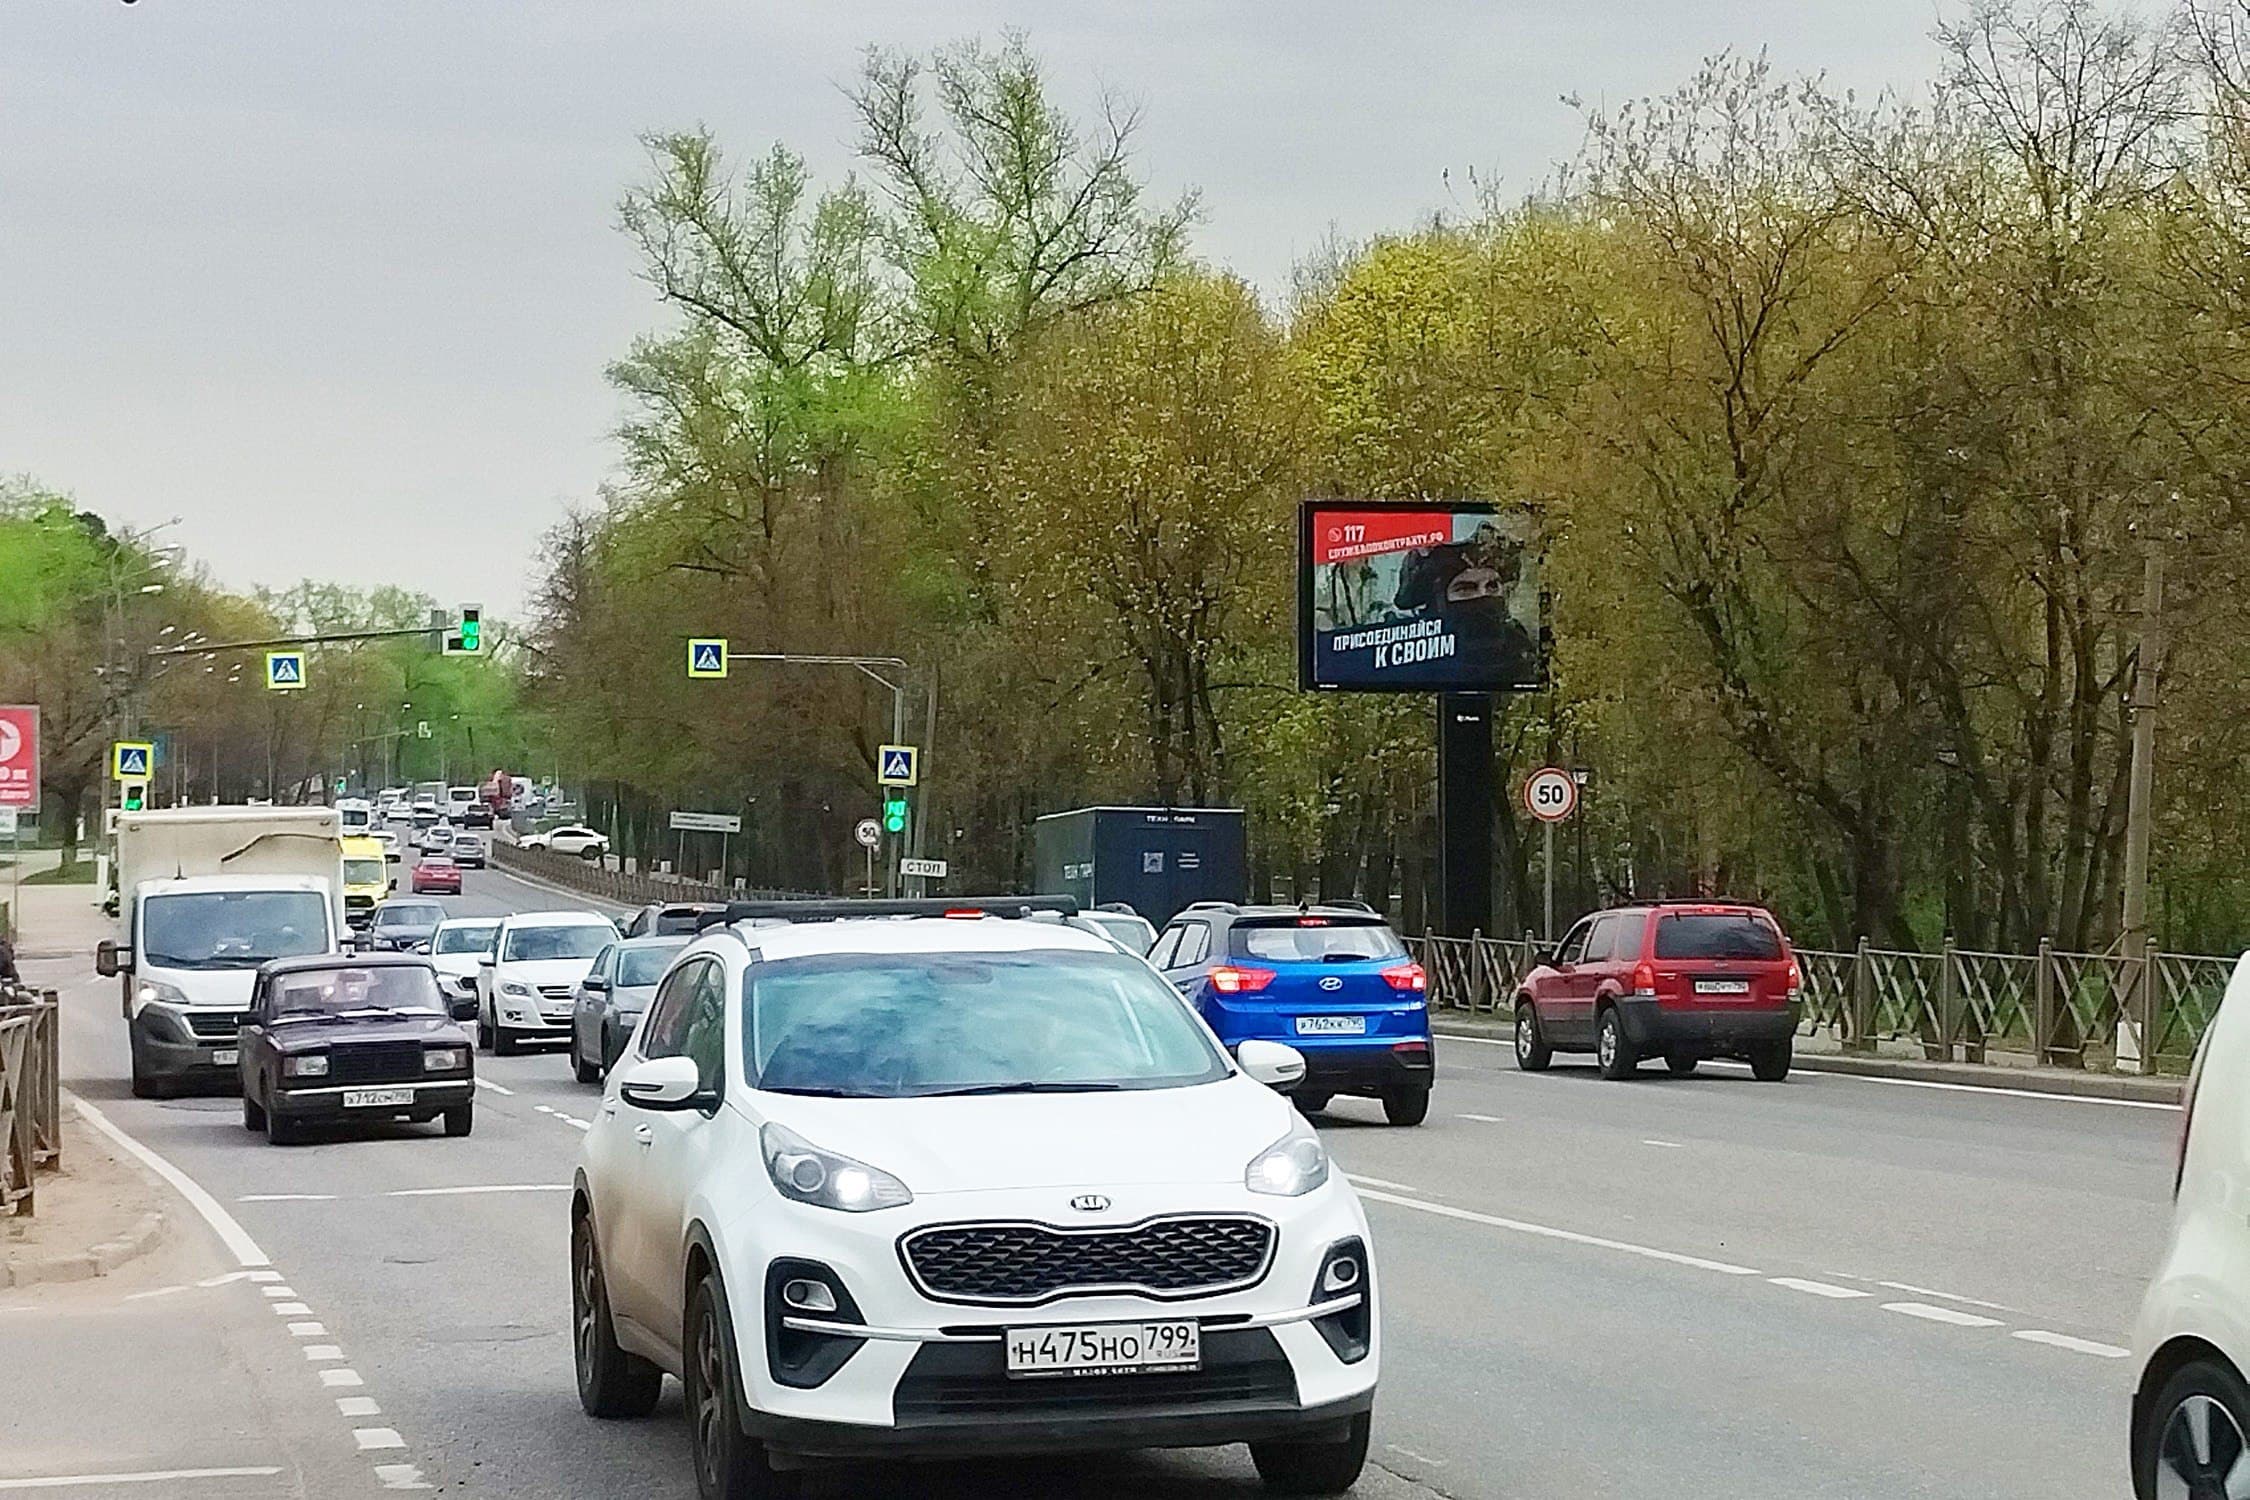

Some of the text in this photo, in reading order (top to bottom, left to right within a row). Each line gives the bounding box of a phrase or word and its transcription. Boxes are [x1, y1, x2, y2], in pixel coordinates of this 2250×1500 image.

[1344, 525, 1365, 542] 117
[1333, 619, 1442, 650] ПРИСОЕДИНЯЙСЯ
[1375, 634, 1455, 668] К СВОИМ
[1538, 784, 1563, 804] 50
[907, 862, 941, 873] СТОП
[1071, 1196, 1110, 1211] KIA
[1145, 1325, 1190, 1350] 799
